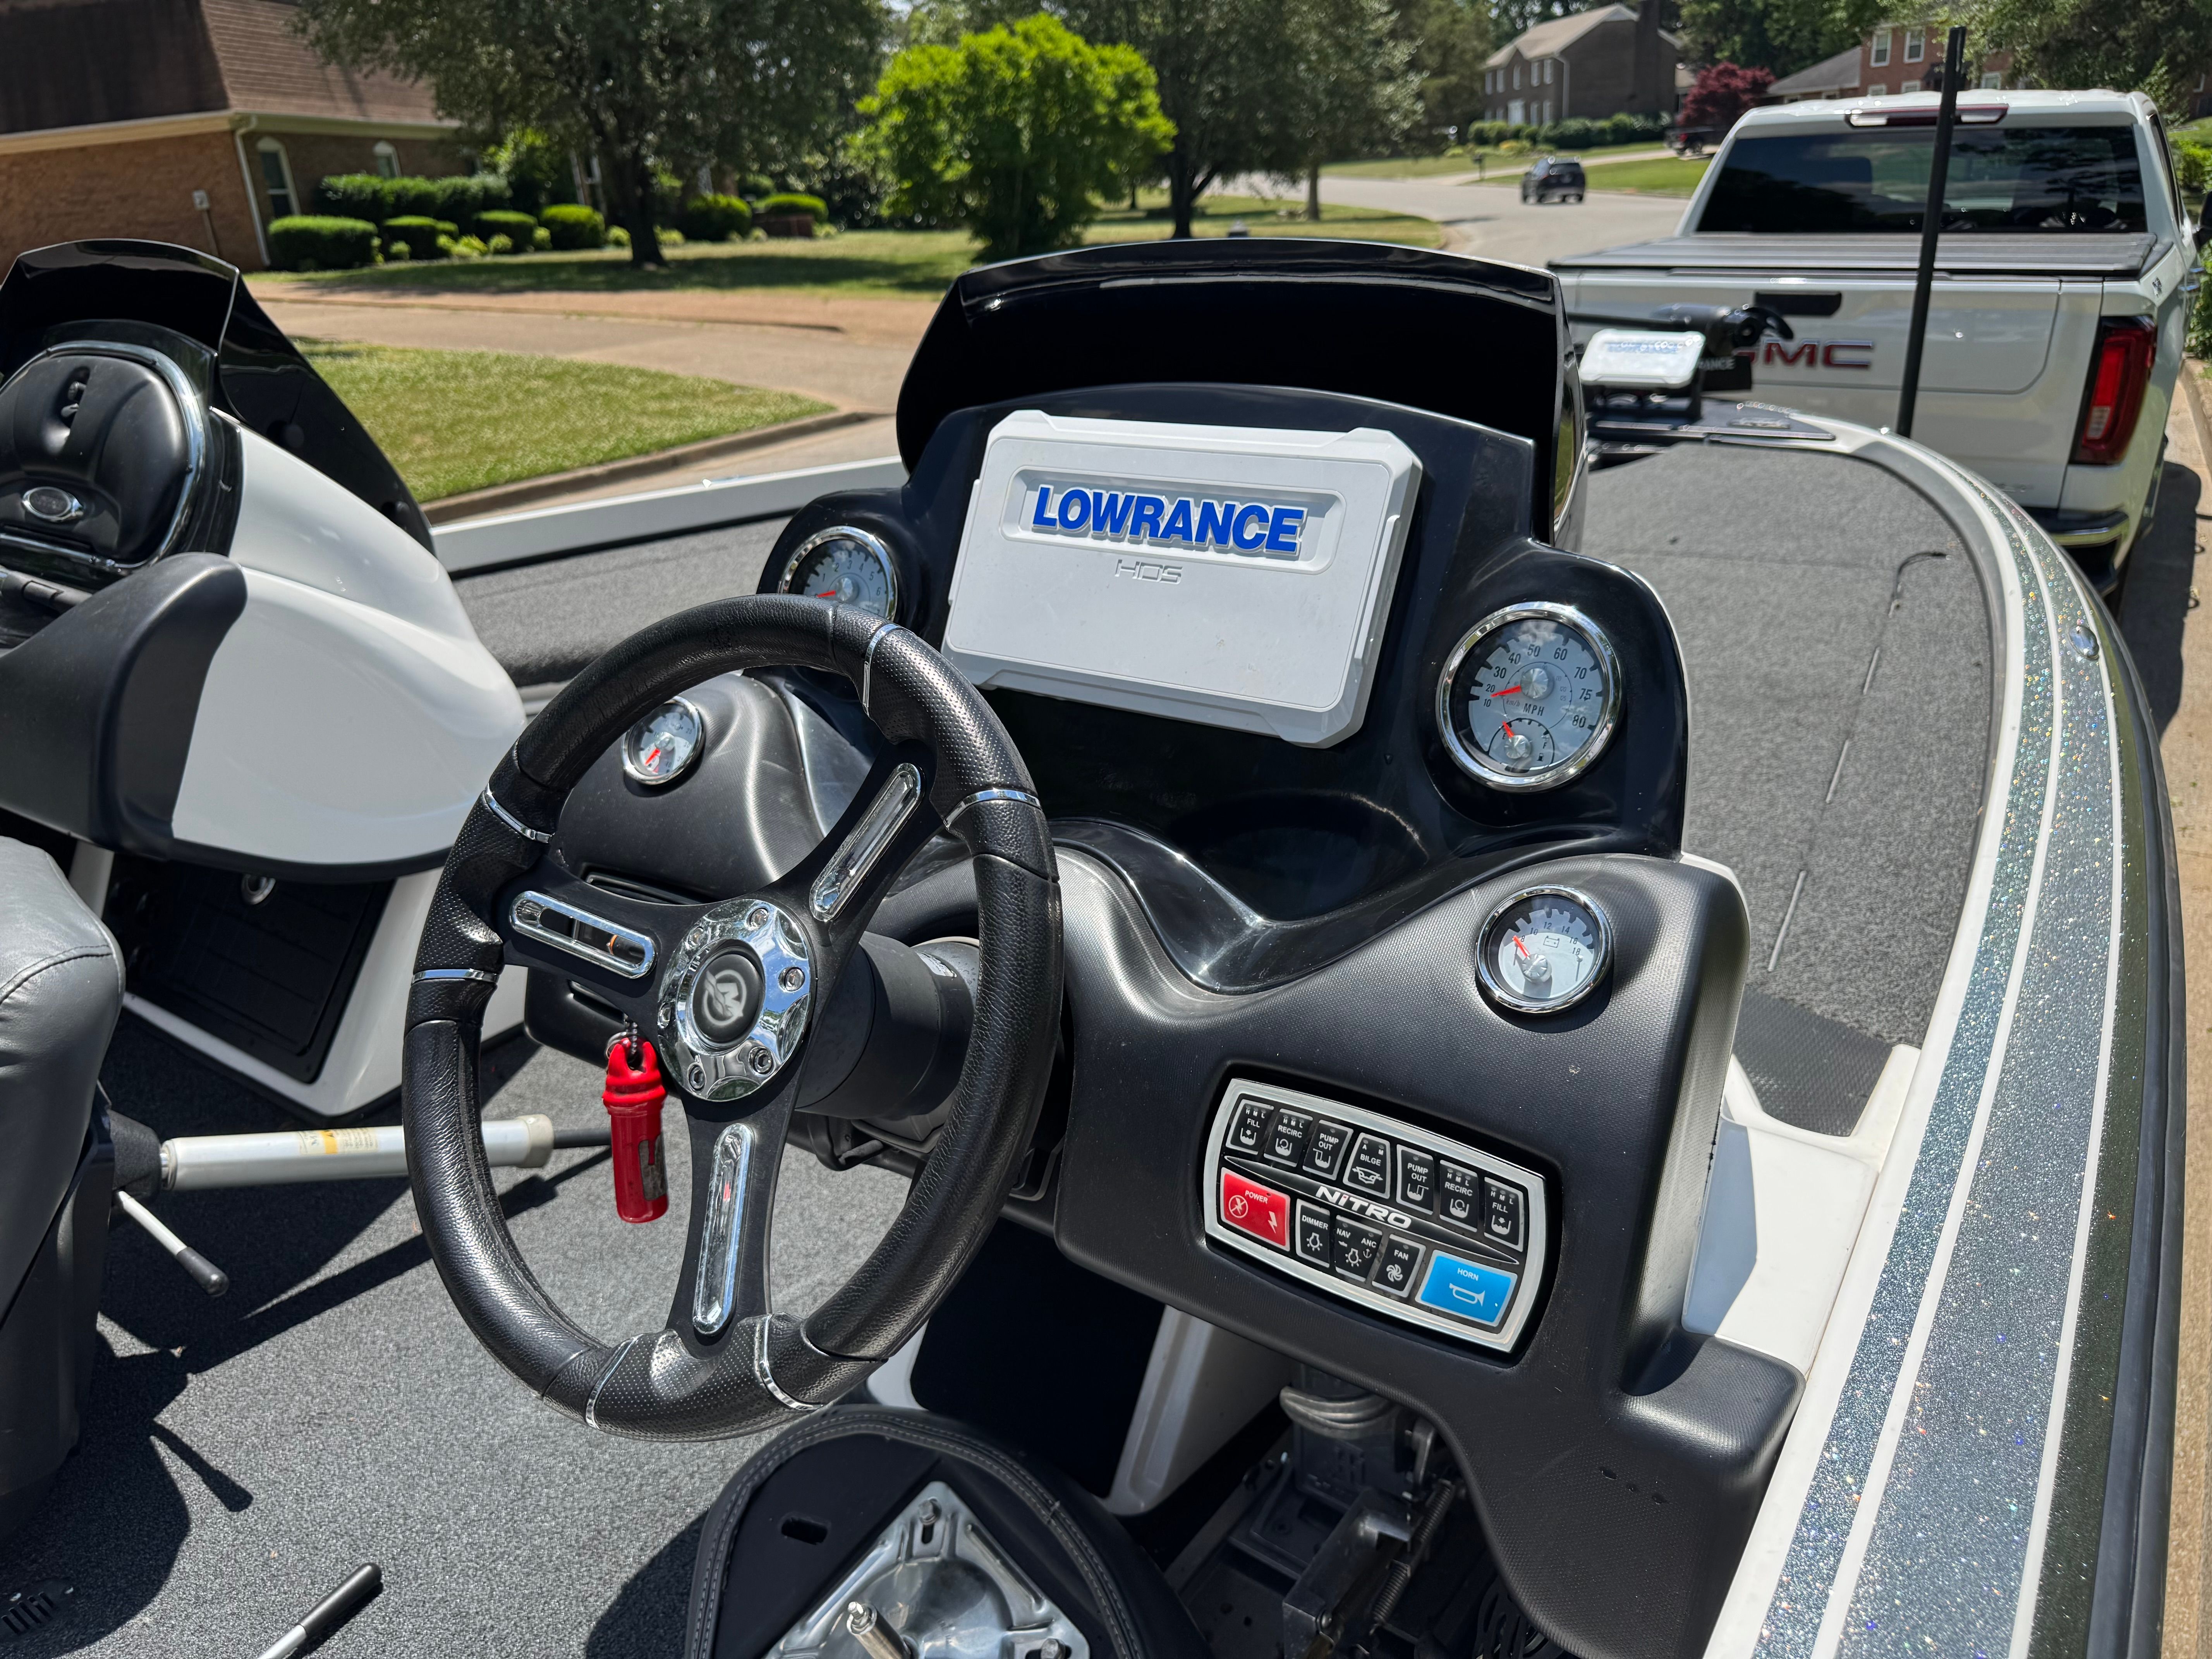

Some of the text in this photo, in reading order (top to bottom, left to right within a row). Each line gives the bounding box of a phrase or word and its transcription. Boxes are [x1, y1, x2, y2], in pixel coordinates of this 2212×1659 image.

[1032, 485, 1307, 556] LOWRANCE
[834, 562, 840, 572] 2
[847, 560, 853, 570] 3
[859, 563, 864, 573] 4
[822, 573, 826, 582] 1
[869, 571, 875, 581] 5
[1115, 559, 1183, 585] HDS
[876, 587, 881, 596] 6
[1527, 644, 1540, 657] 50
[1553, 647, 1568, 661] 60
[1508, 652, 1521, 665] 40
[1493, 666, 1507, 679] 30
[1574, 667, 1587, 680] 70
[1485, 684, 1495, 693] 20
[1579, 688, 1593, 701] 75
[1483, 698, 1492, 708] 10
[1506, 698, 1520, 707] km/h
[1523, 703, 1545, 716] MPH
[1571, 715, 1586, 728] 80
[1543, 921, 1553, 930] 12
[1561, 926, 1571, 934] 14
[1530, 927, 1539, 936] 10
[1569, 937, 1579, 945] 16
[1572, 947, 1581, 955] 18
[1247, 1118, 1260, 1128] FILL
[1278, 1125, 1302, 1138] RECIRC
[1319, 1133, 1339, 1144] PUMP
[1318, 1141, 1333, 1151] OUT
[1360, 1154, 1381, 1166] BILGE
[1407, 1163, 1428, 1174] PUMP
[1411, 1173, 1427, 1182] OUT
[1444, 1182, 1473, 1196] RECIRC
[1245, 1190, 1268, 1204] POWER
[1316, 1186, 1411, 1229] NITRO
[1492, 1202, 1508, 1213] FILL
[1302, 1215, 1329, 1230] DIMMER
[1336, 1228, 1351, 1238] NAV
[1361, 1238, 1377, 1248] ANC
[1394, 1249, 1408, 1261] FAN
[1457, 1267, 1479, 1281] HORN
